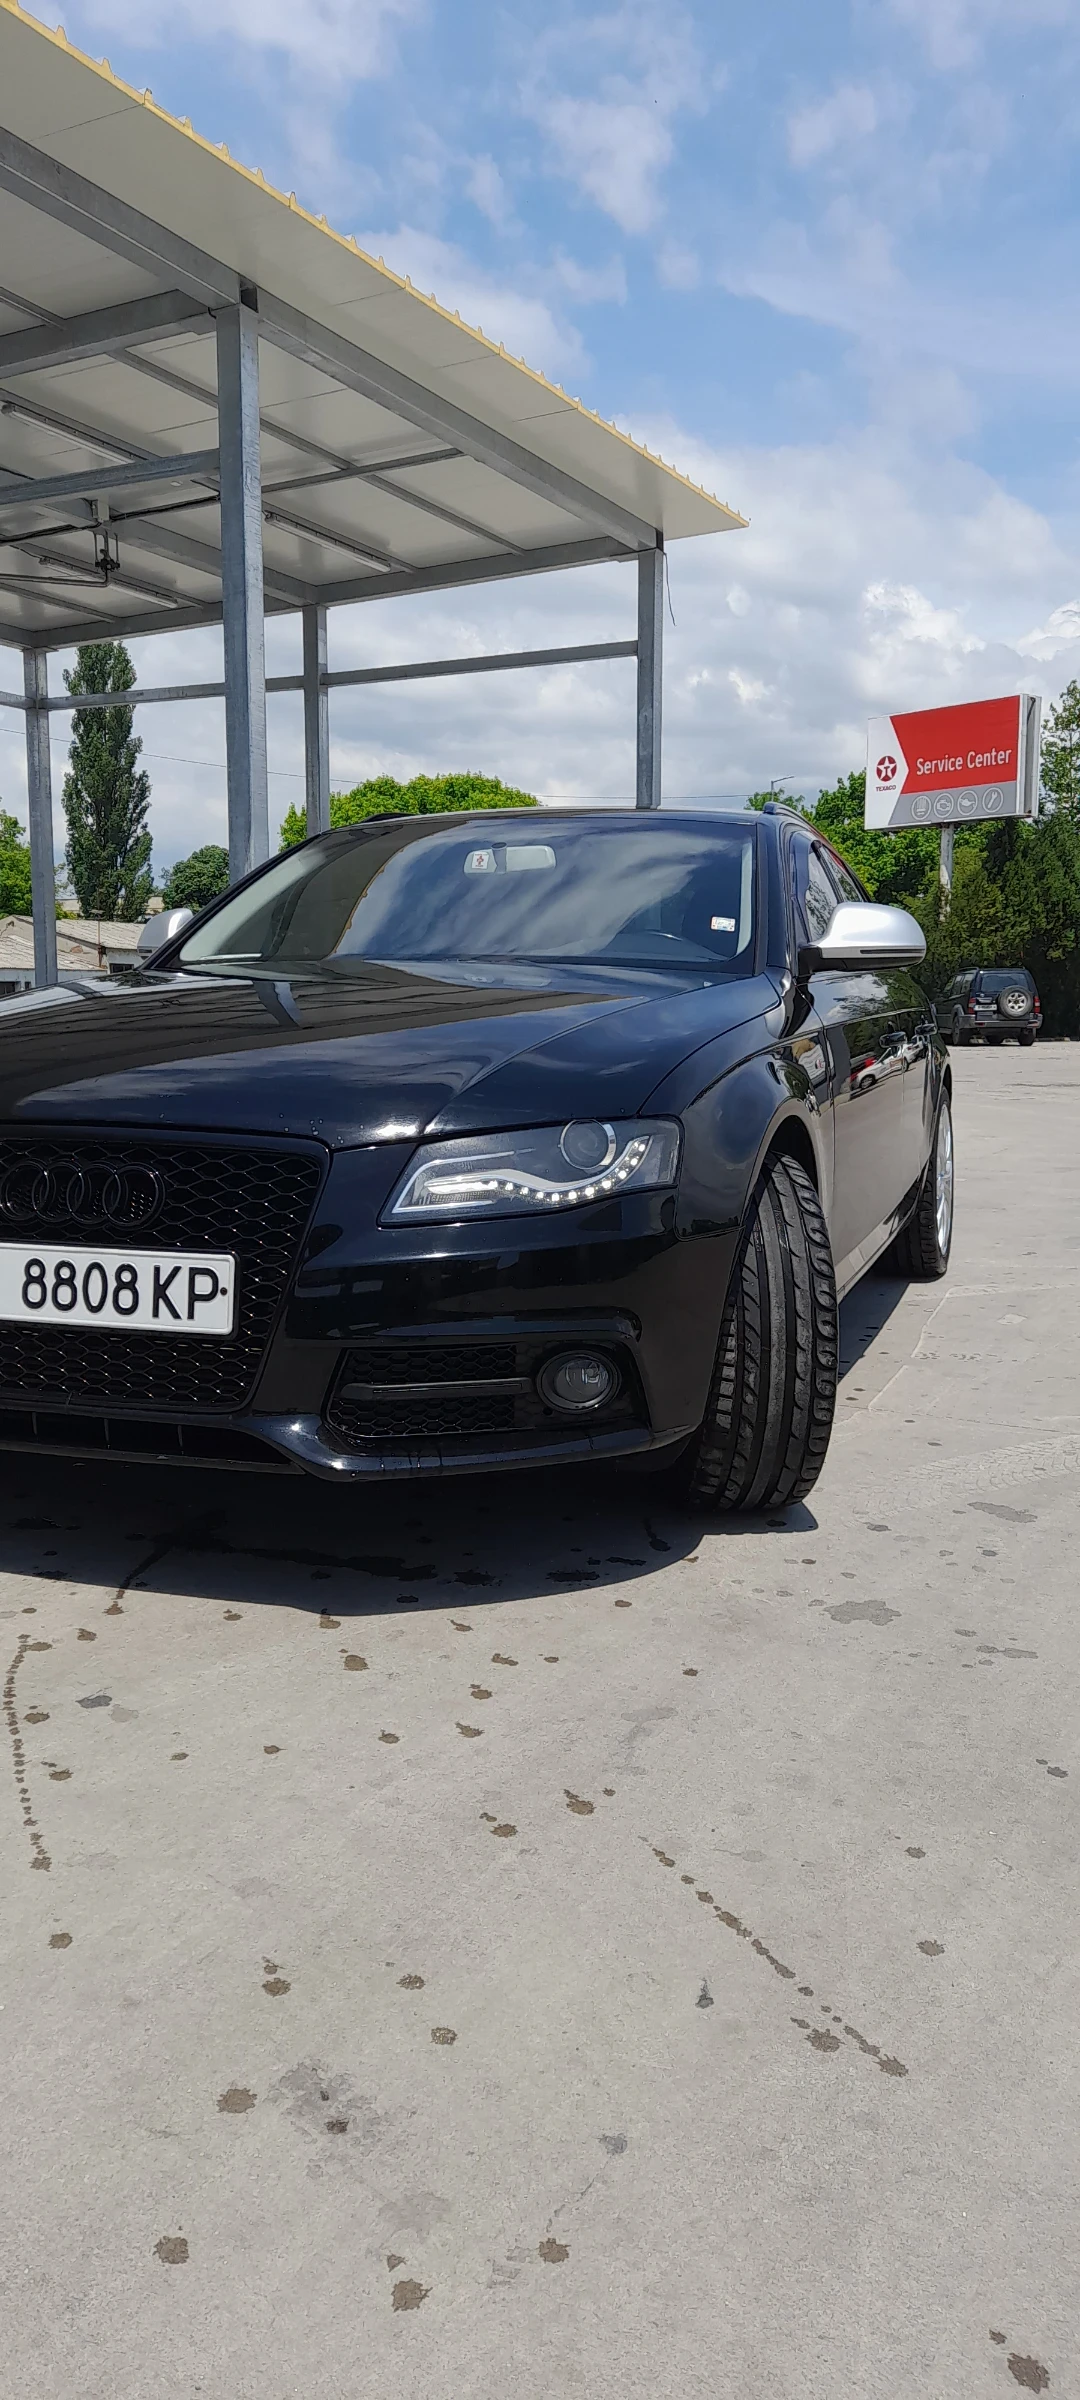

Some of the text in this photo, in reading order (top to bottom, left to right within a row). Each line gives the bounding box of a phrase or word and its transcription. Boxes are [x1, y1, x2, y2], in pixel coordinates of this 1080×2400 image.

[916, 747, 1012, 776] Service Center
[21, 1257, 220, 1321] 8808 KP
